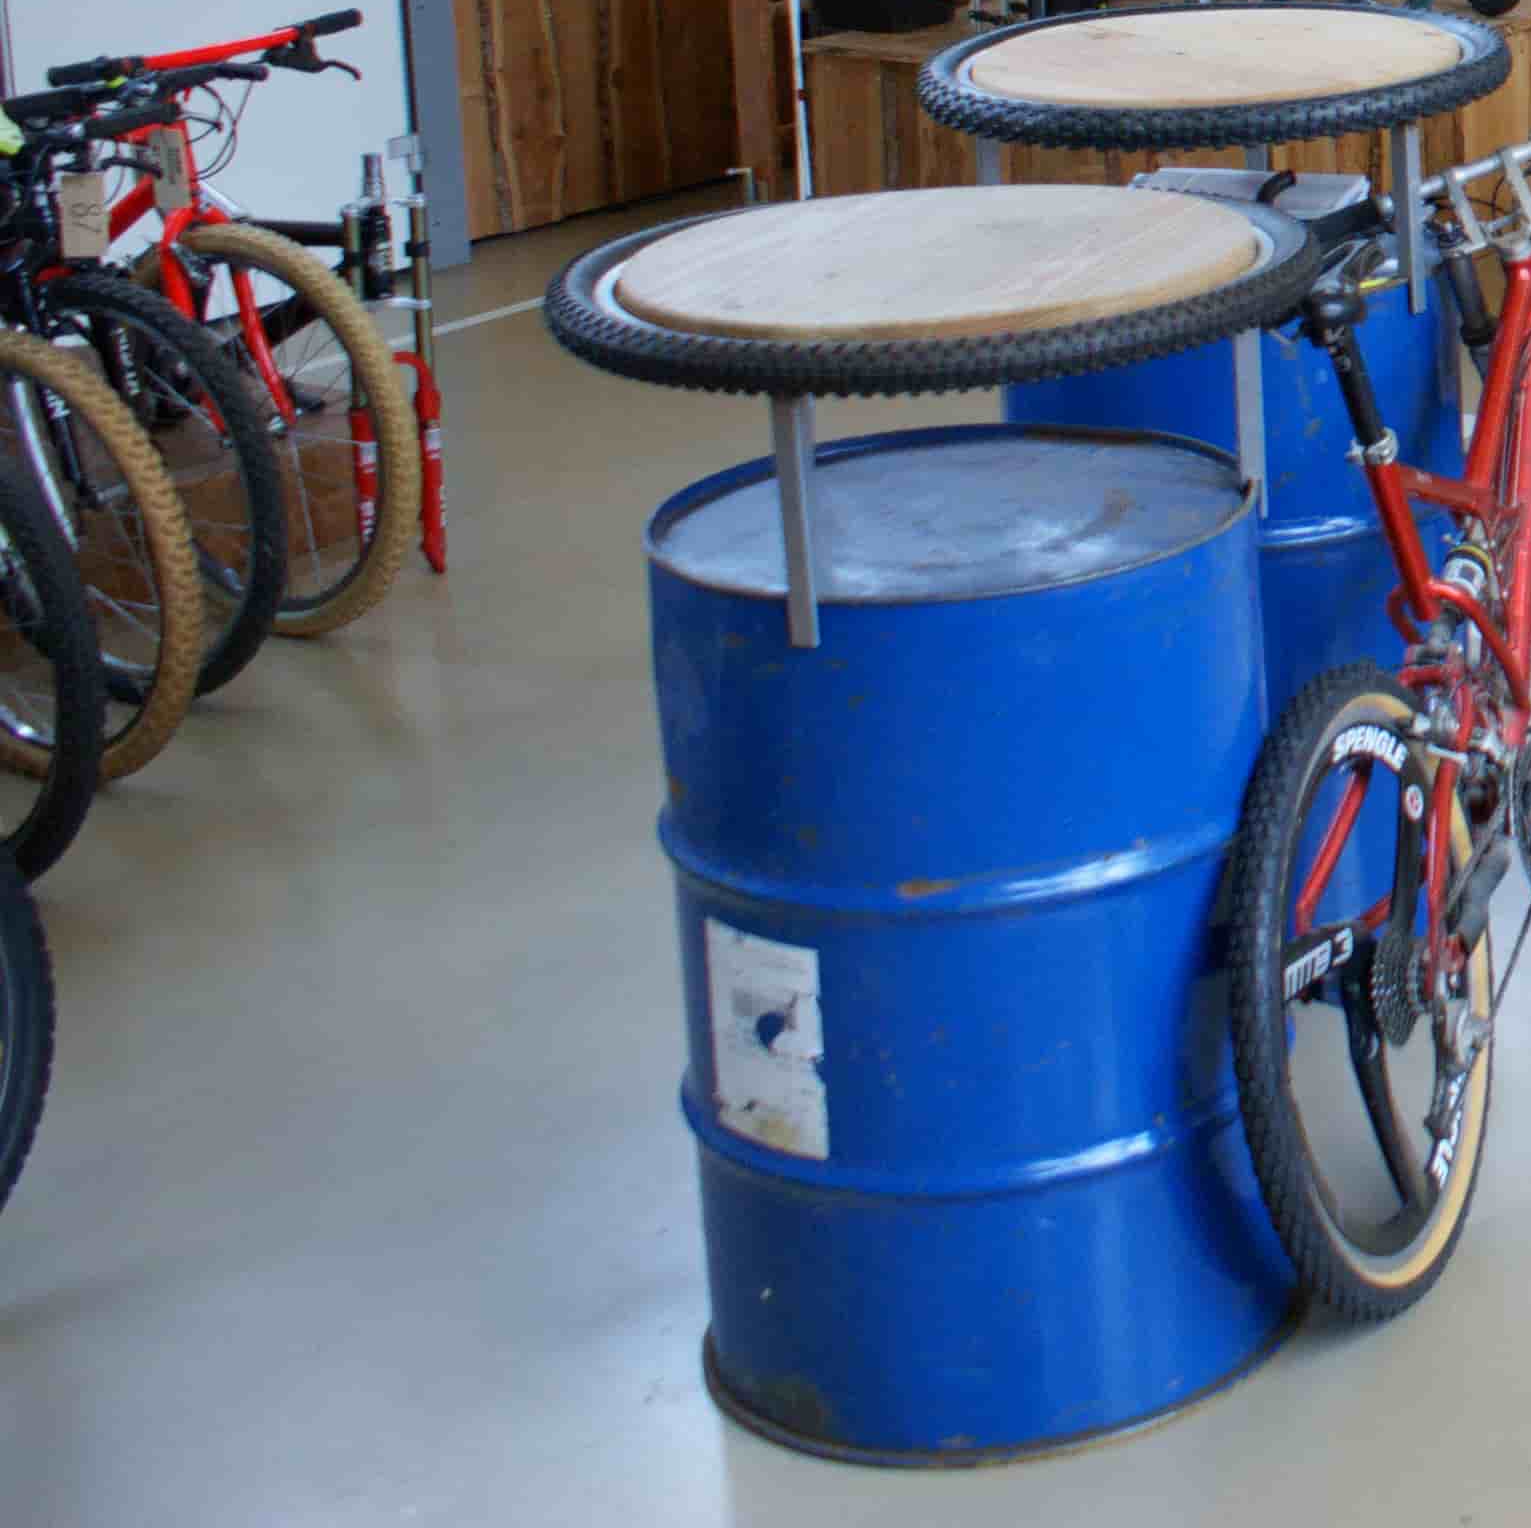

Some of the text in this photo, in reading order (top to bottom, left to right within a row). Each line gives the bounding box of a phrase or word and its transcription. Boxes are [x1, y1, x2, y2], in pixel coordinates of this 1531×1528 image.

[1332, 724, 1408, 772] SPENGLE
[1284, 926, 1354, 1002] MTB 3
